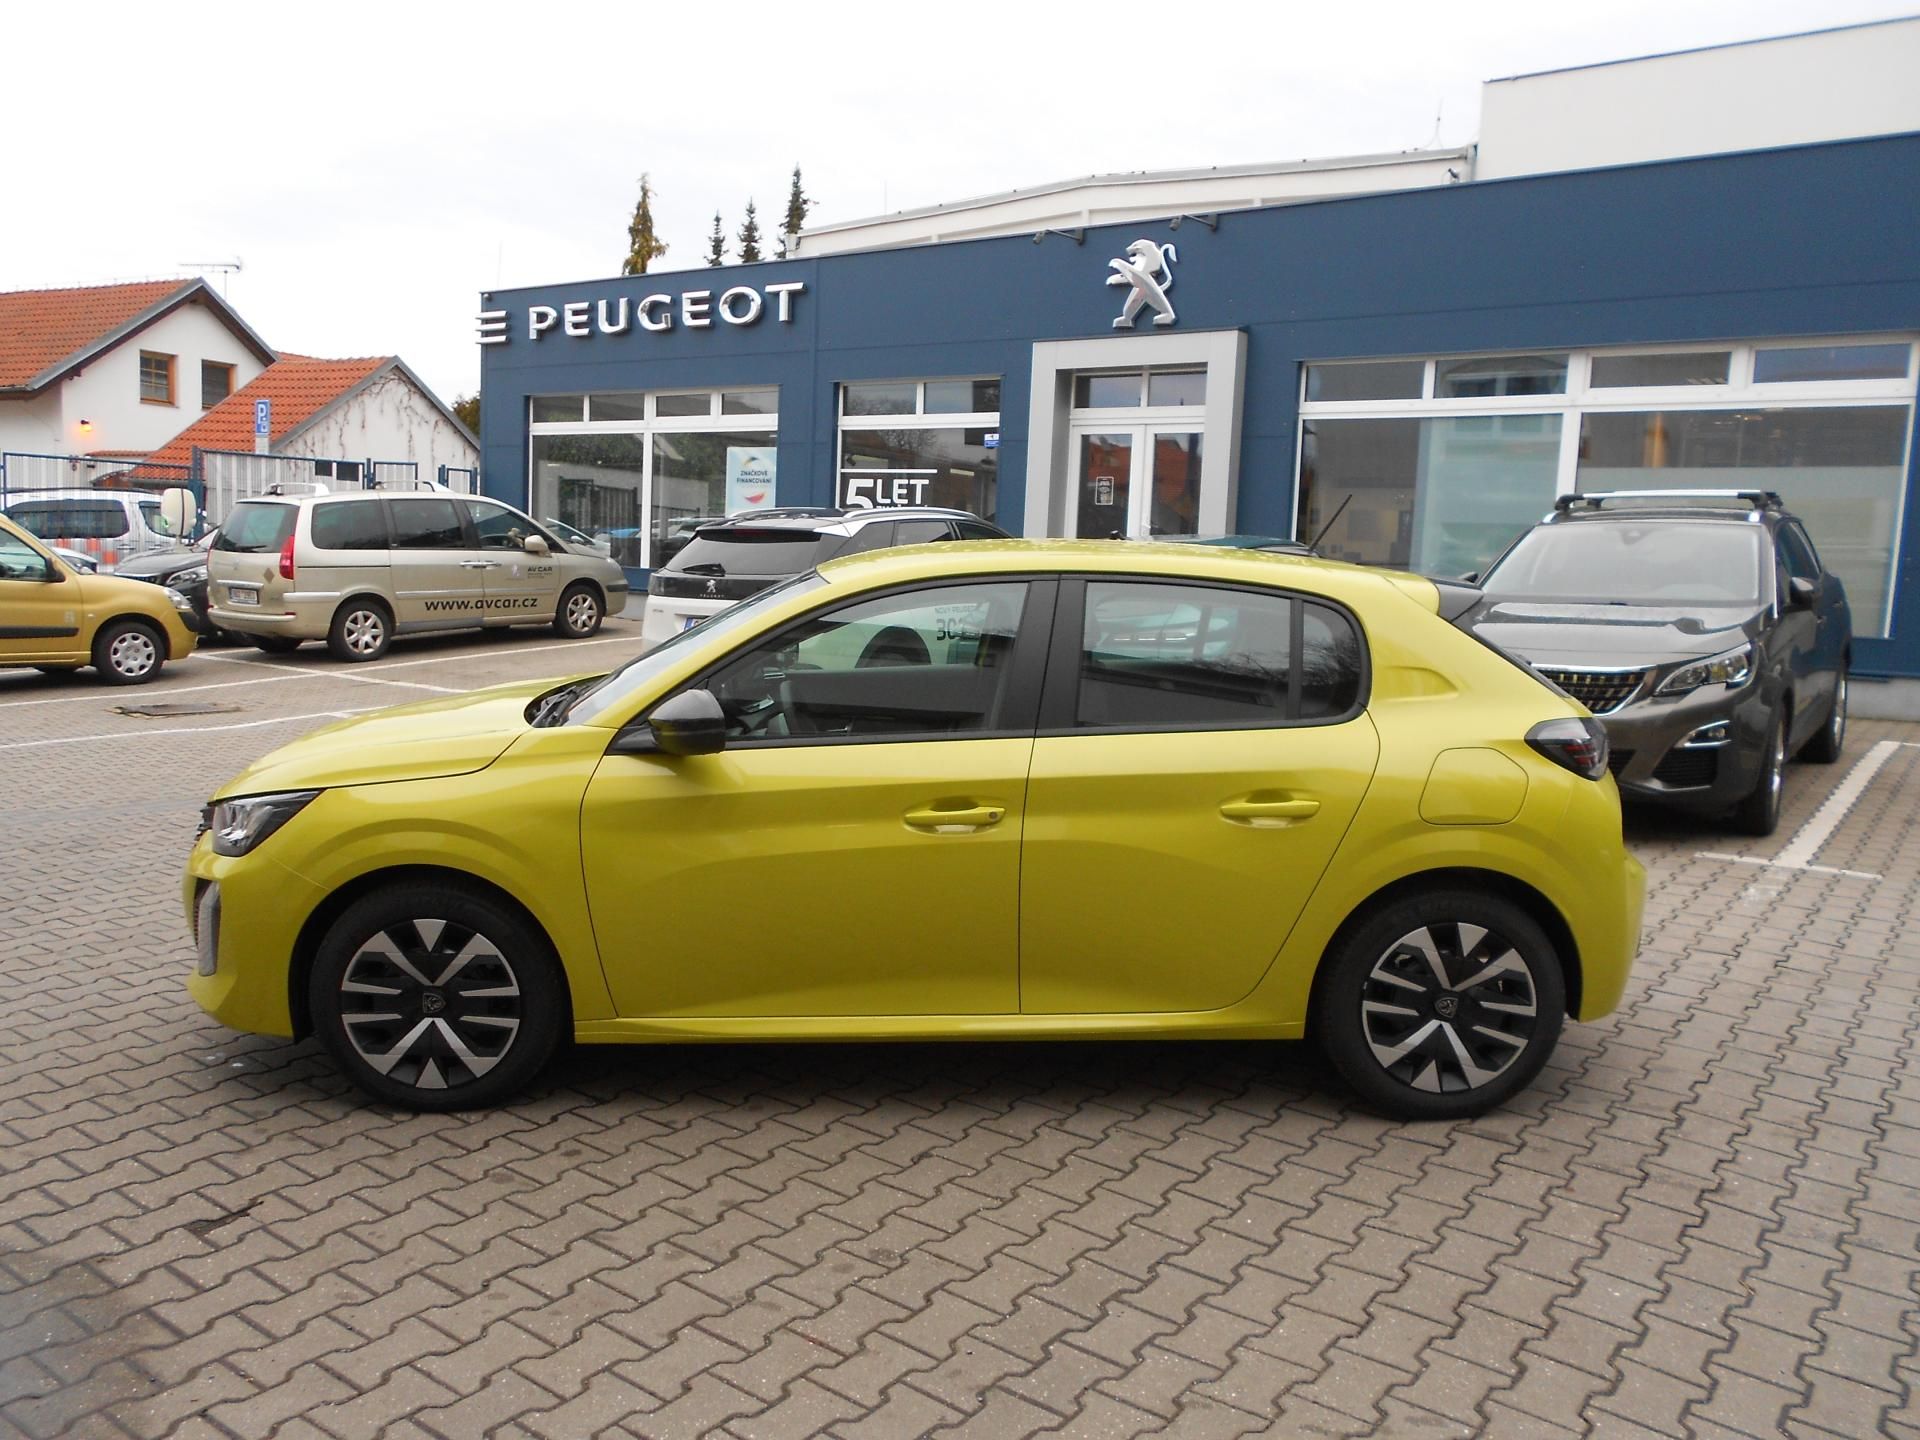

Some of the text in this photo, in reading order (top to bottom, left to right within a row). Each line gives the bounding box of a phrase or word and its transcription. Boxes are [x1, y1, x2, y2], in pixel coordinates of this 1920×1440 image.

[528, 281, 804, 340] PEUGEOT
[257, 403, 266, 425] P
[846, 478, 930, 509] 5 LET
[424, 597, 539, 611] www.avcar.cz
